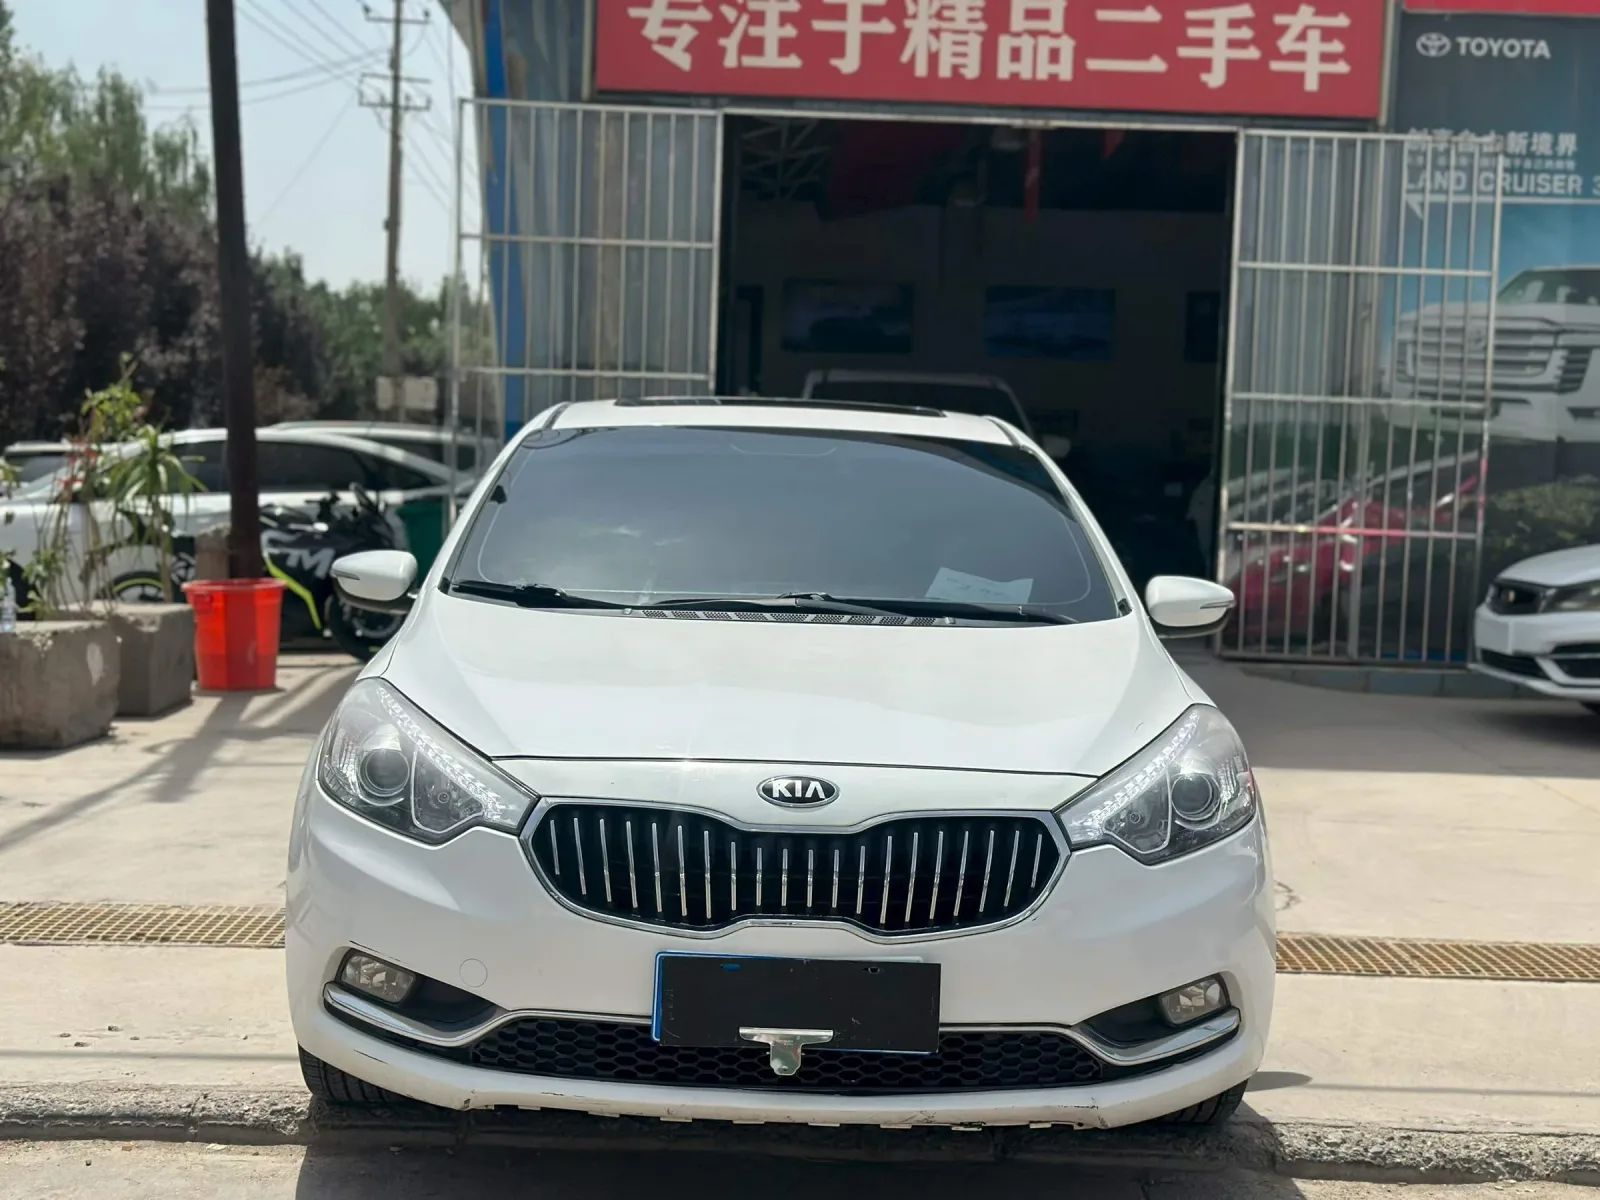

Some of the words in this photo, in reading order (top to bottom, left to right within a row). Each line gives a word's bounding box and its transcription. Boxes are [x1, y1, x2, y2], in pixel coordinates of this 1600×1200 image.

[627, 0, 1352, 93] 专注于精品二手车
[1456, 36, 1551, 60] TOYOTA
[1479, 171, 1583, 195] CRUISER
[772, 779, 826, 799] KIA
